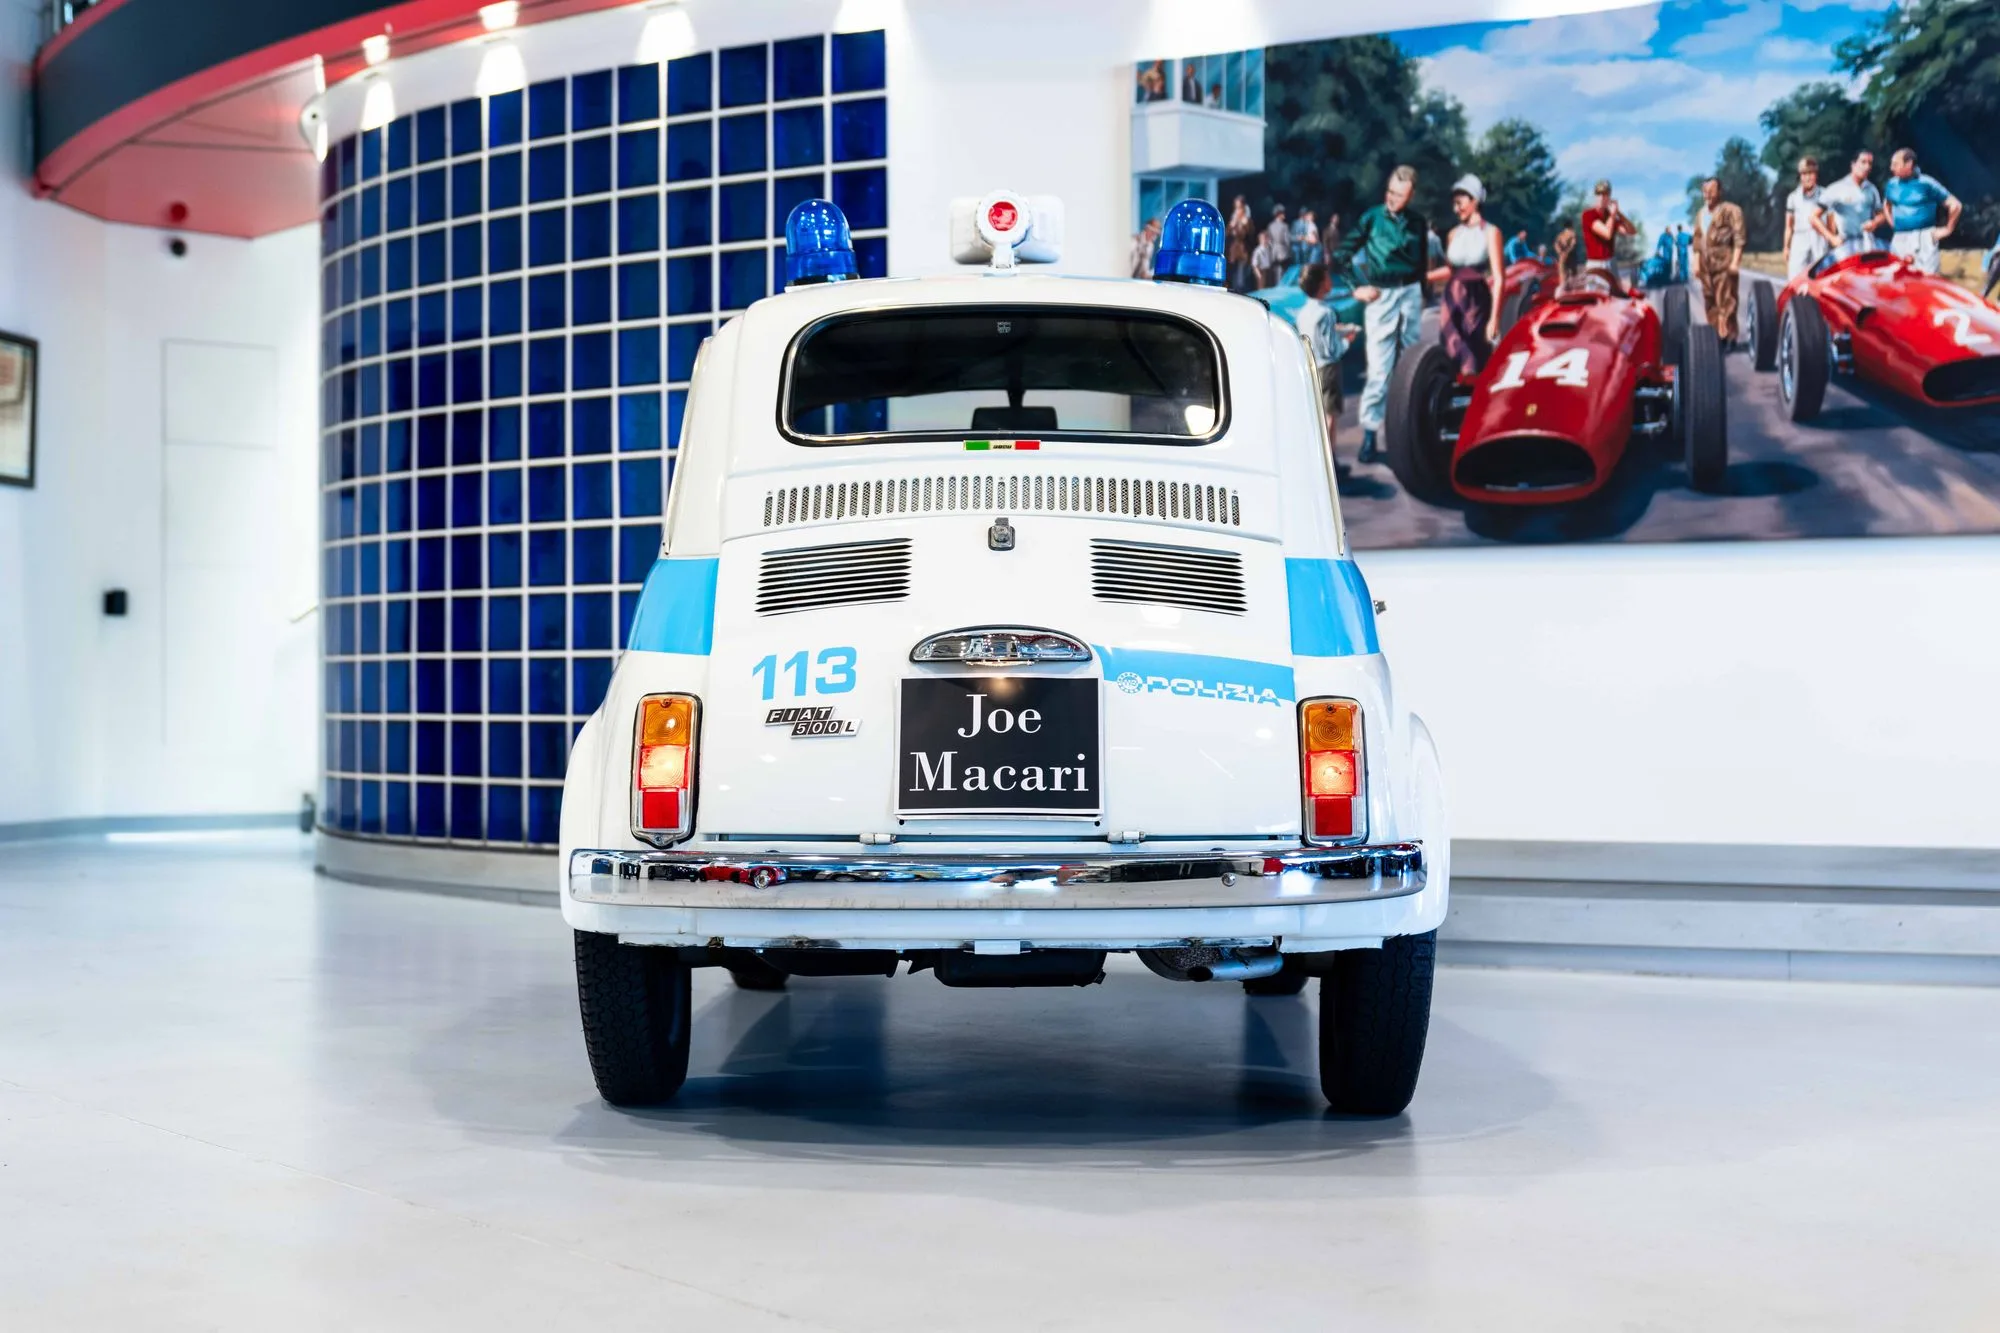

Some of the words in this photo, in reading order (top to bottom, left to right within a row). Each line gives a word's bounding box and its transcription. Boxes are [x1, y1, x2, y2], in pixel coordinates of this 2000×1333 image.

[1489, 347, 1590, 394] 14
[752, 646, 857, 700] 113
[1146, 675, 1281, 707] POLIZIA
[769, 708, 831, 722] FIAT
[957, 693, 1042, 738] Joe
[909, 751, 1089, 792] Macari
